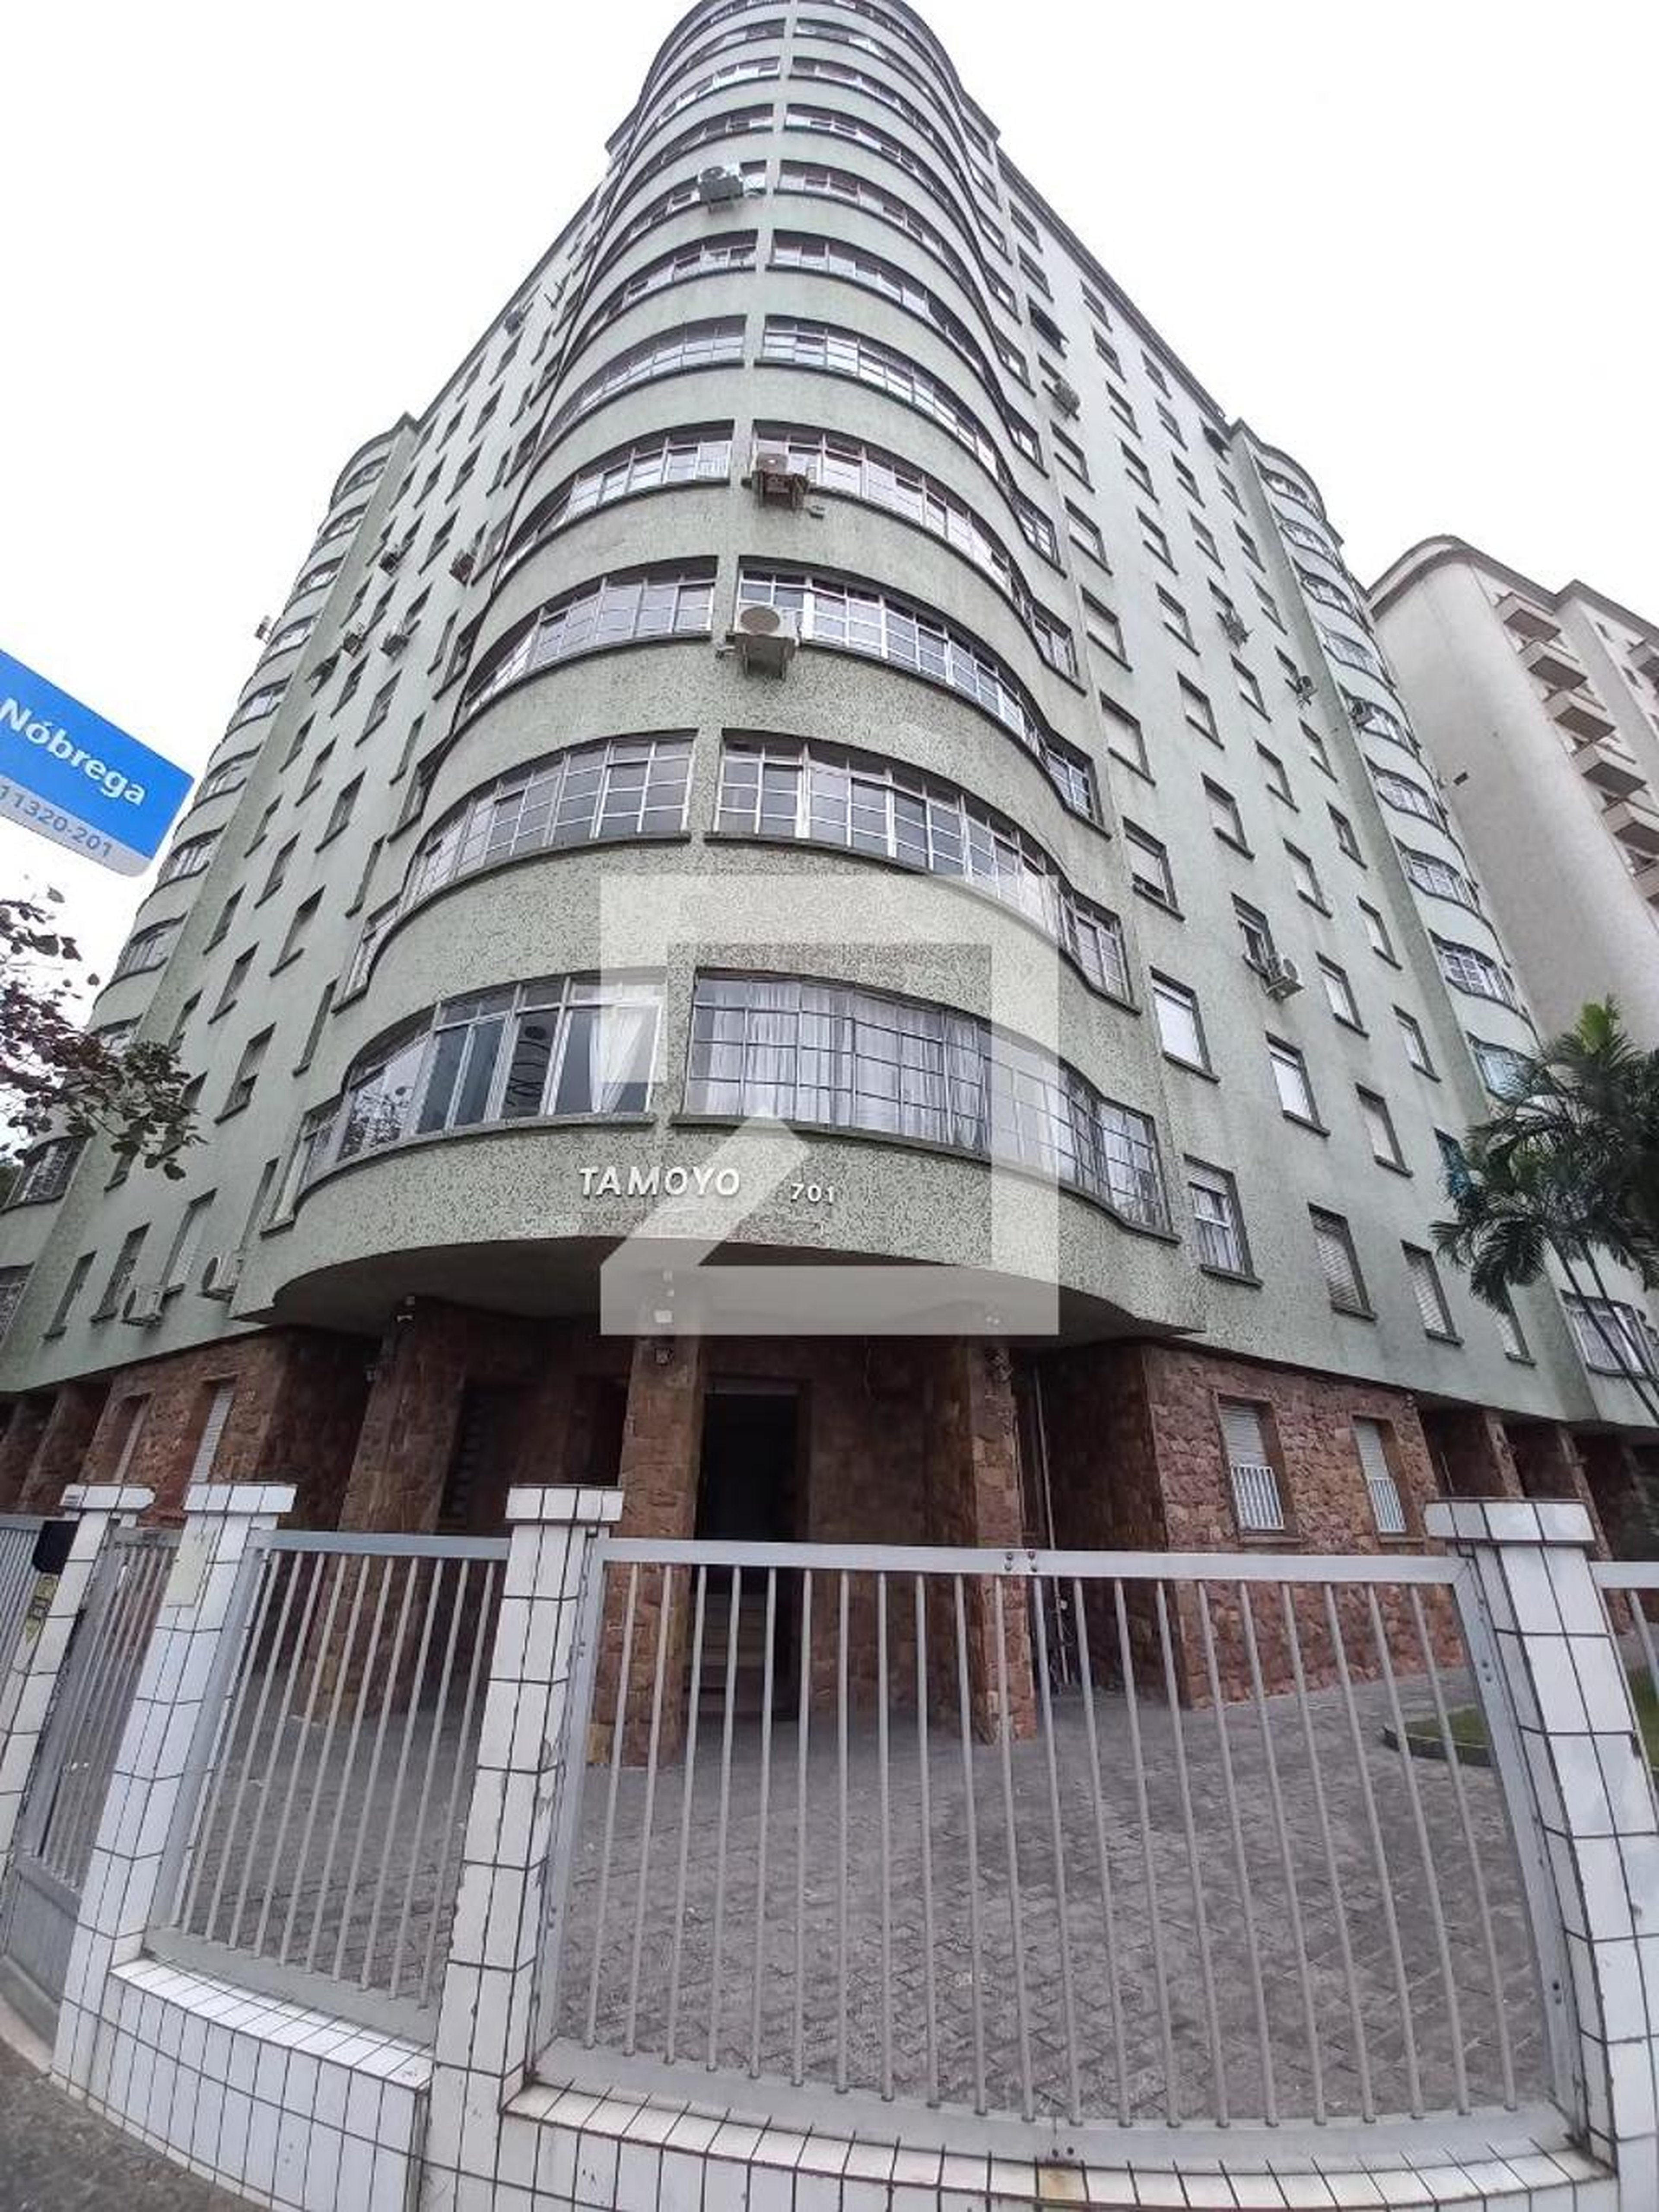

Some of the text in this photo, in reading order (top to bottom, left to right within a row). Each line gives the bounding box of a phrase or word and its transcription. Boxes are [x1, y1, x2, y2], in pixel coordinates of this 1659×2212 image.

[0, 697, 144, 805] Nóbrega
[578, 1166, 834, 1202] TAMOYO 701
